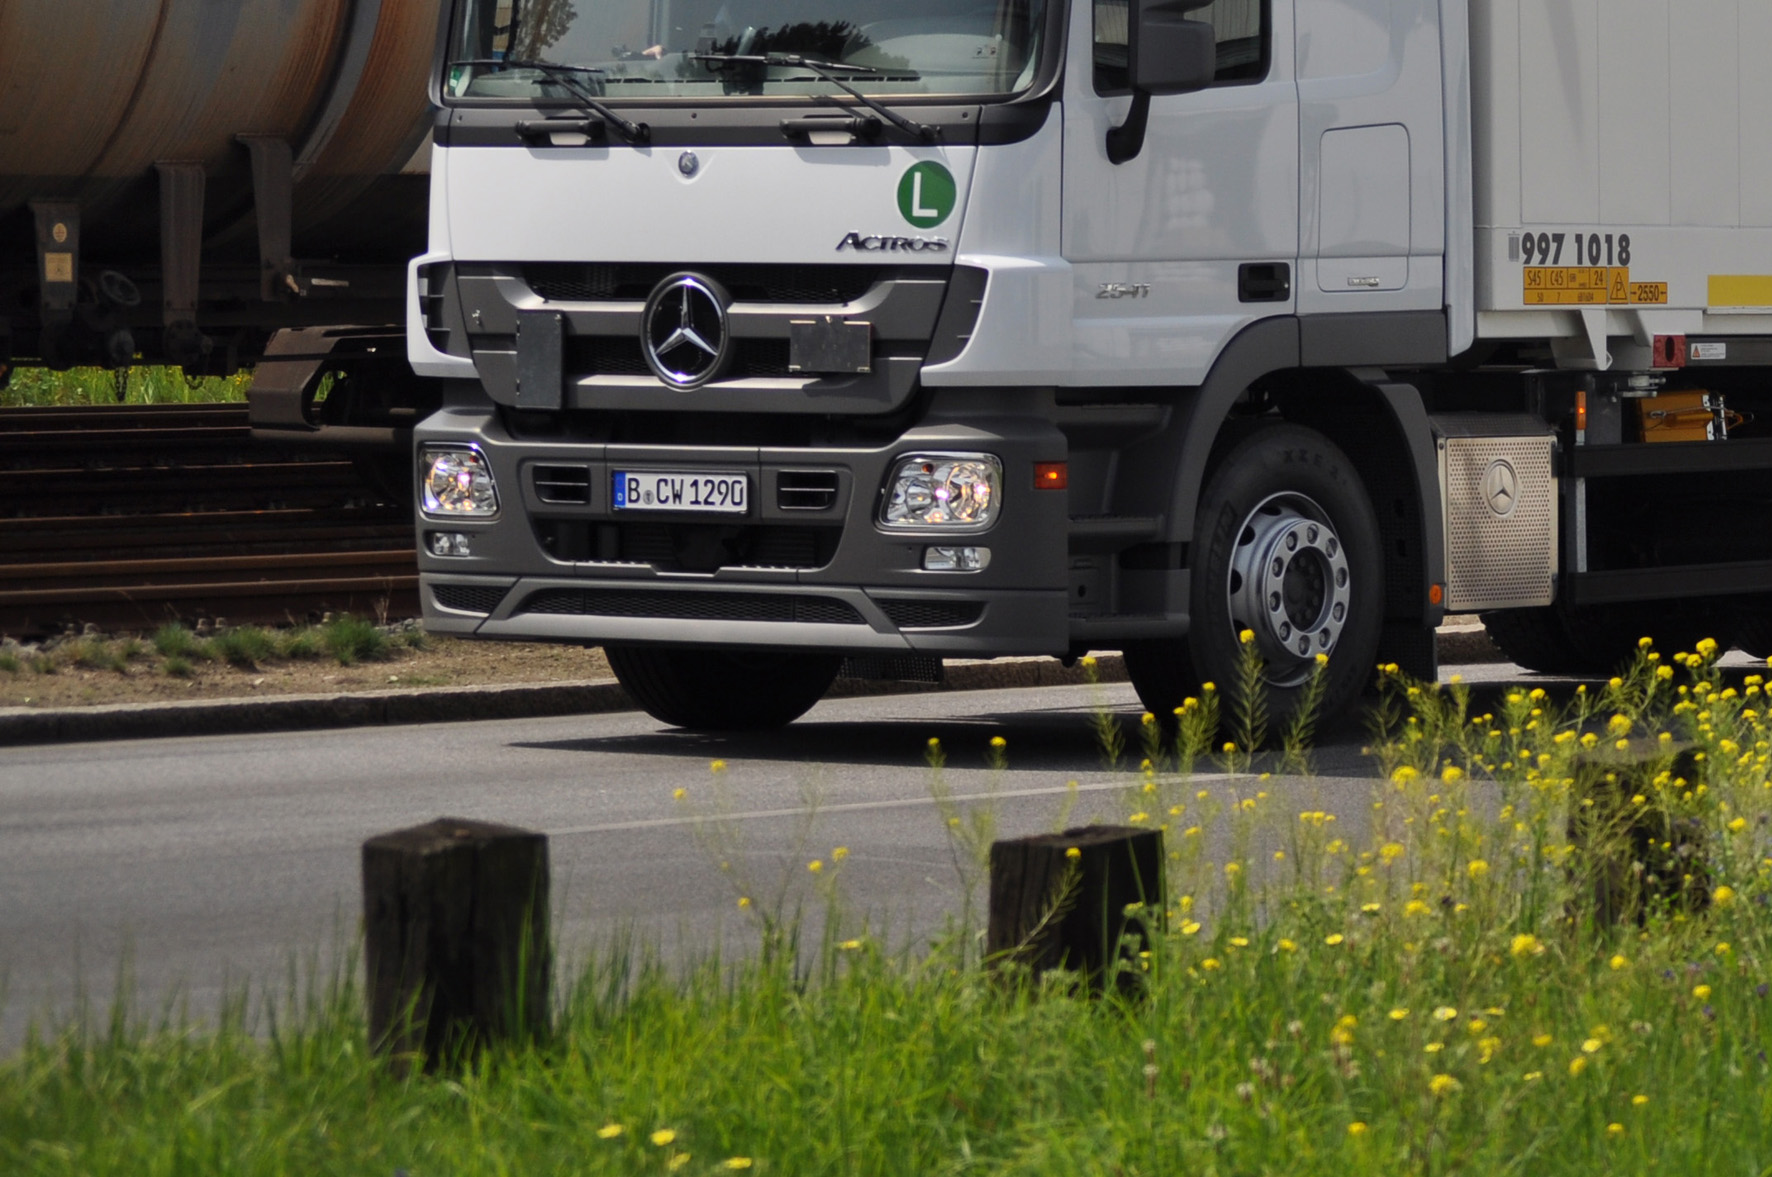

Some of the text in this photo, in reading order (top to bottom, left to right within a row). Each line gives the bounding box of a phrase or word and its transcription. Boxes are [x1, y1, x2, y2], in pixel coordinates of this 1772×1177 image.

[912, 171, 938, 217] L
[1521, 232, 1631, 266] 997 1018
[1528, 270, 1541, 286] S45
[1550, 270, 1564, 286] C45
[1594, 270, 1604, 286] 24
[1637, 285, 1660, 302] 2550
[628, 477, 744, 506] B CW 1290
